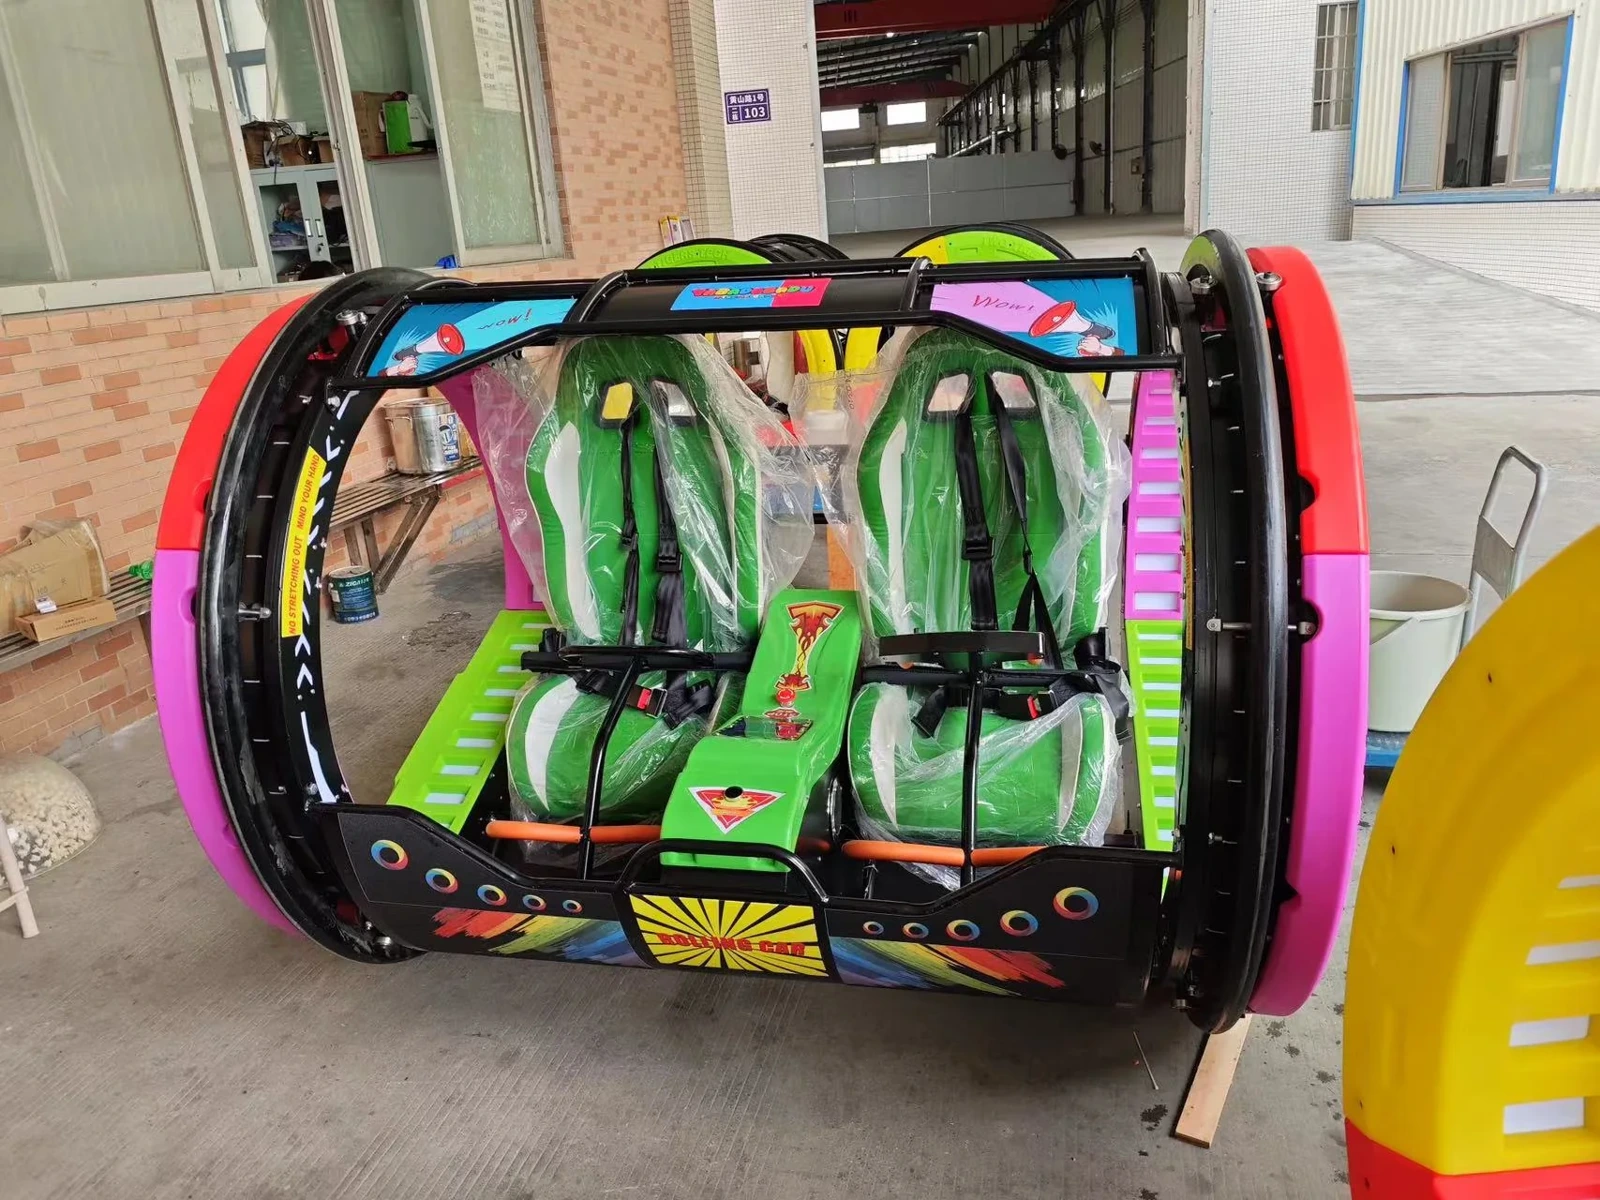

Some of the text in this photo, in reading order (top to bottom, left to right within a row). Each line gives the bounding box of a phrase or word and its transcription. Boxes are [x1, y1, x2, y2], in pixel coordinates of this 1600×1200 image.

[730, 94, 763, 104] 黄山路1号
[745, 107, 765, 118] 103
[288, 454, 321, 635] NO STRETCHING OUT MIND YOUR HAND
[657, 933, 805, 956] ROLLING CAR
